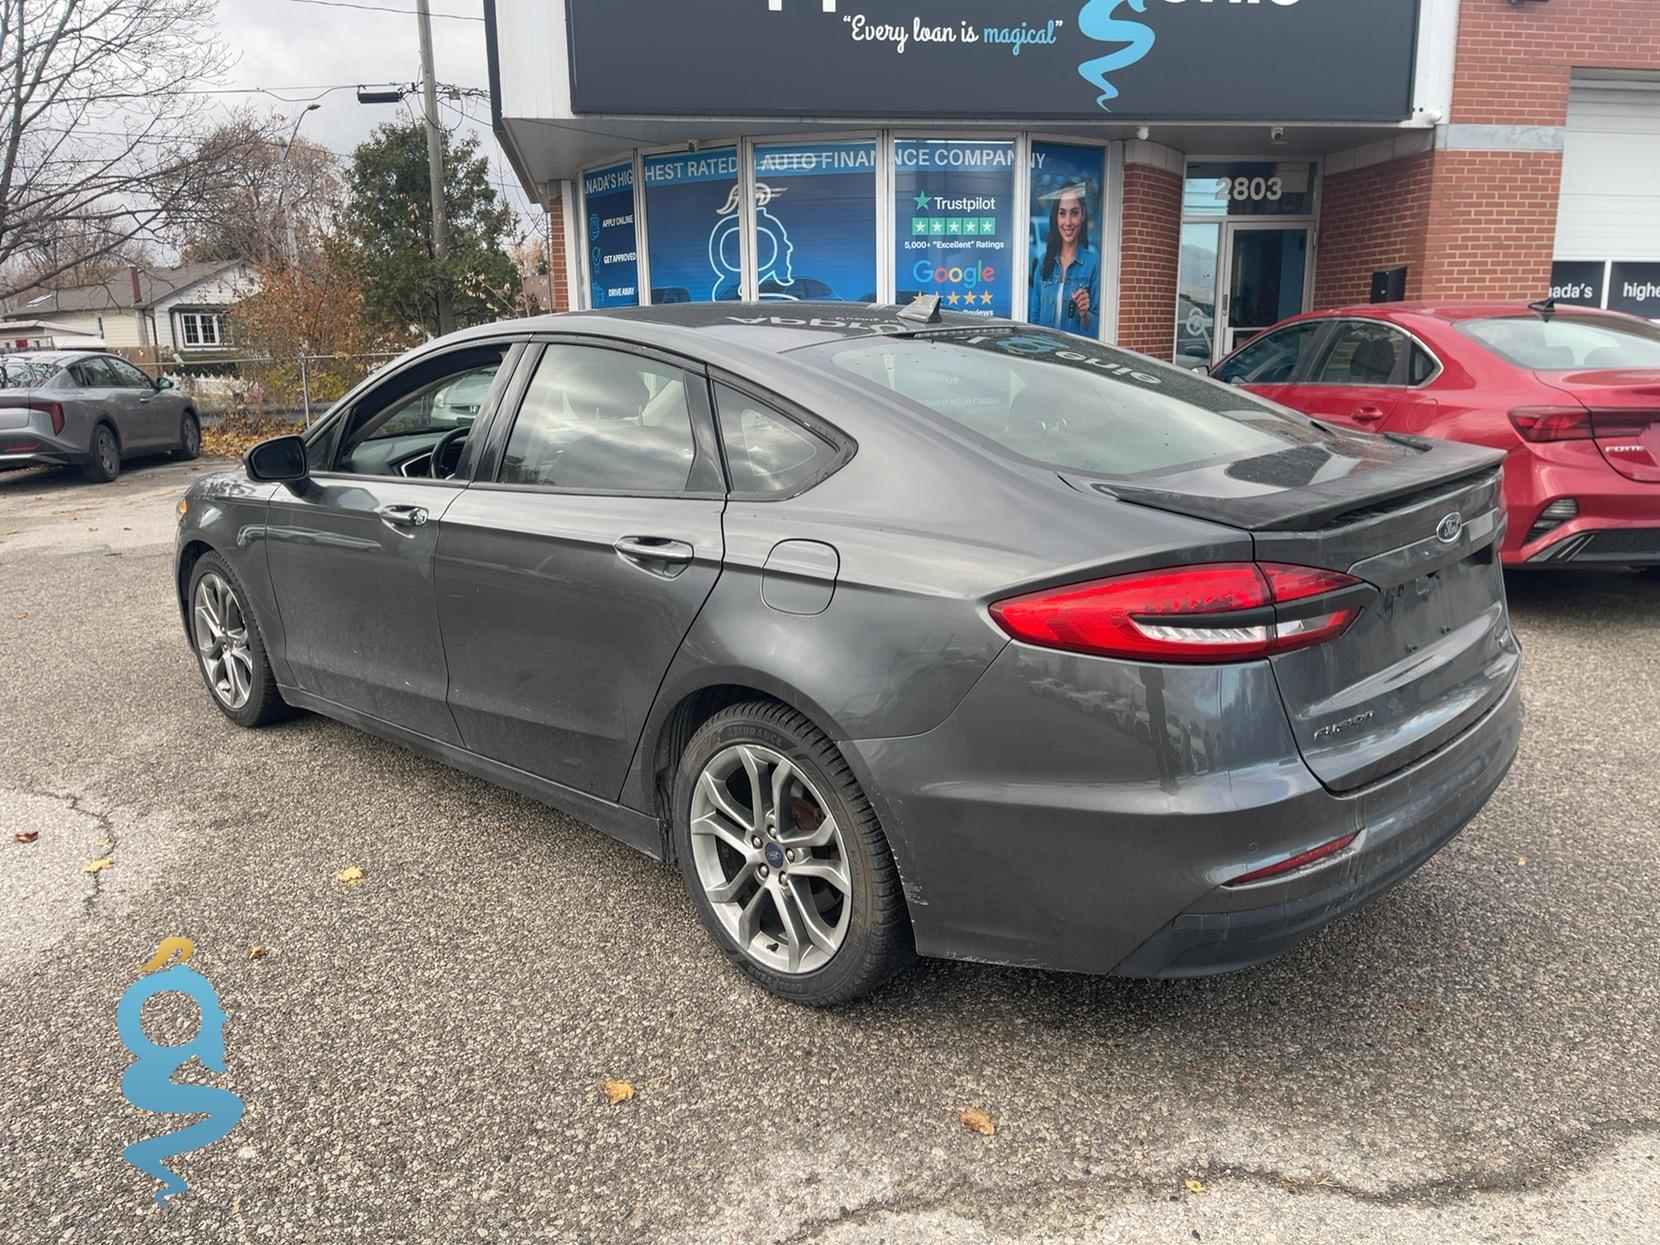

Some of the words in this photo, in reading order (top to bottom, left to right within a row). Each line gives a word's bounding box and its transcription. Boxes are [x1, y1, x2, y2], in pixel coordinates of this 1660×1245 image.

[913, 17, 956, 42] loan
[961, 21, 979, 42] is
[585, 173, 617, 194] NADA'S
[688, 157, 738, 177] RATED
[761, 153, 816, 171] AUTO
[1216, 176, 1282, 201] 2803
[934, 197, 996, 212] Trustpilot
[602, 218, 616, 228] APPLY
[616, 214, 634, 226] ONLINE
[904, 241, 931, 250] 5,000+
[976, 241, 1005, 250] Ratings
[603, 254, 612, 264] GET
[612, 252, 637, 263] APPROVED
[912, 259, 995, 288] Google
[608, 288, 622, 297] DRIVE
[621, 286, 635, 296] AWAY
